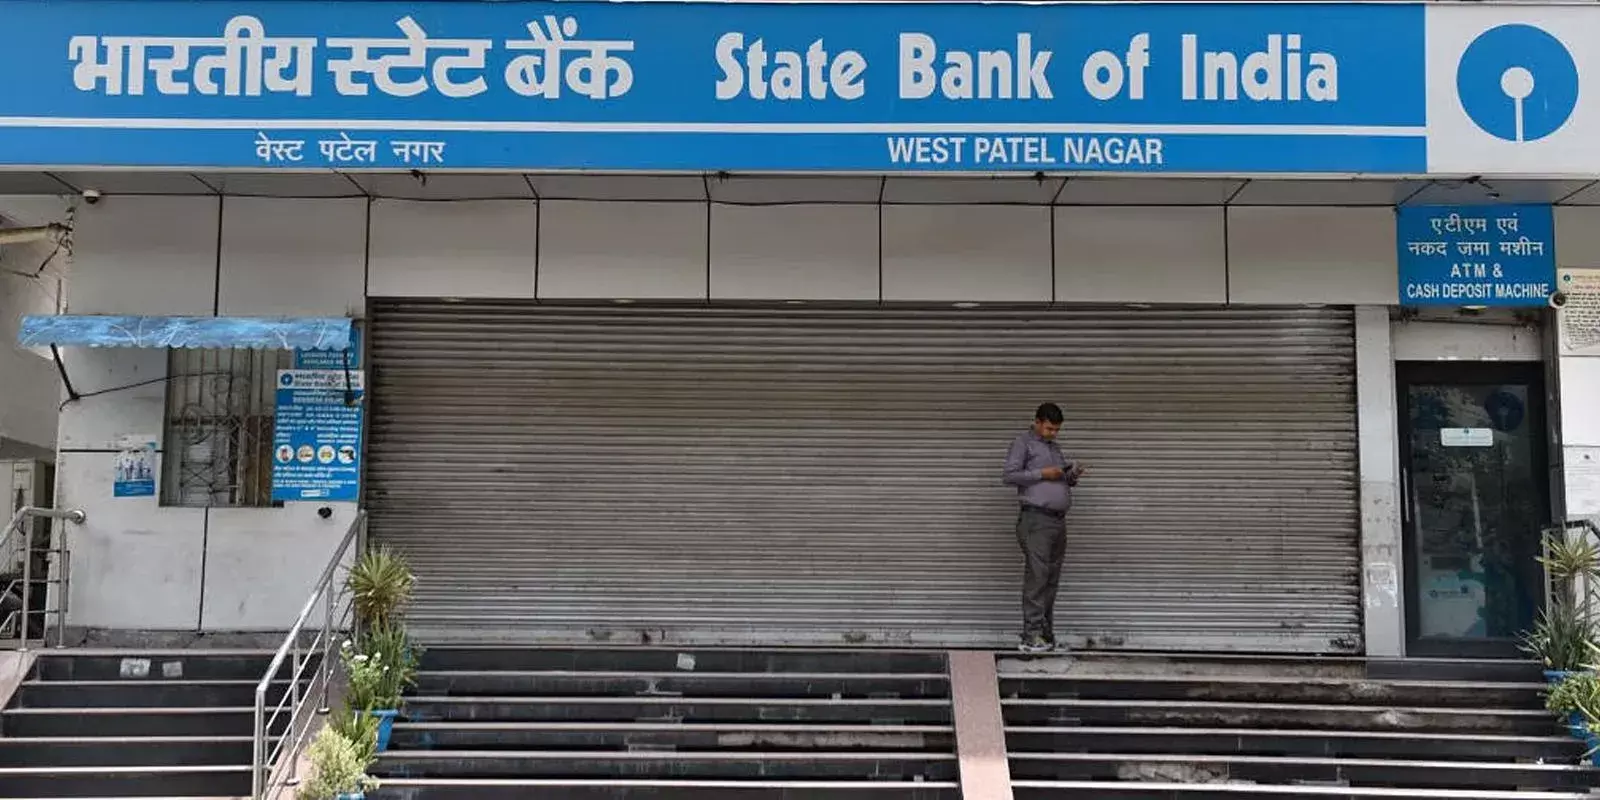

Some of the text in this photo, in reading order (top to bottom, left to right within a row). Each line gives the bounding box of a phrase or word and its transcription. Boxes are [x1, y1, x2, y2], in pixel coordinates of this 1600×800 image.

[68, 15, 634, 99] भारतीय स्टेट बैंक
[715, 32, 1338, 101] State Bank of India
[255, 131, 445, 164] वेस्ट पटेल नगर
[887, 137, 1163, 164] WEST PATEL NAGAR
[1430, 212, 1519, 235] एटीएम एवं
[1408, 236, 1544, 256] नकद जमा मशीन
[1450, 263, 1503, 278] ATM &
[1407, 283, 1549, 298] CASH DEPOSIT MACHINE
